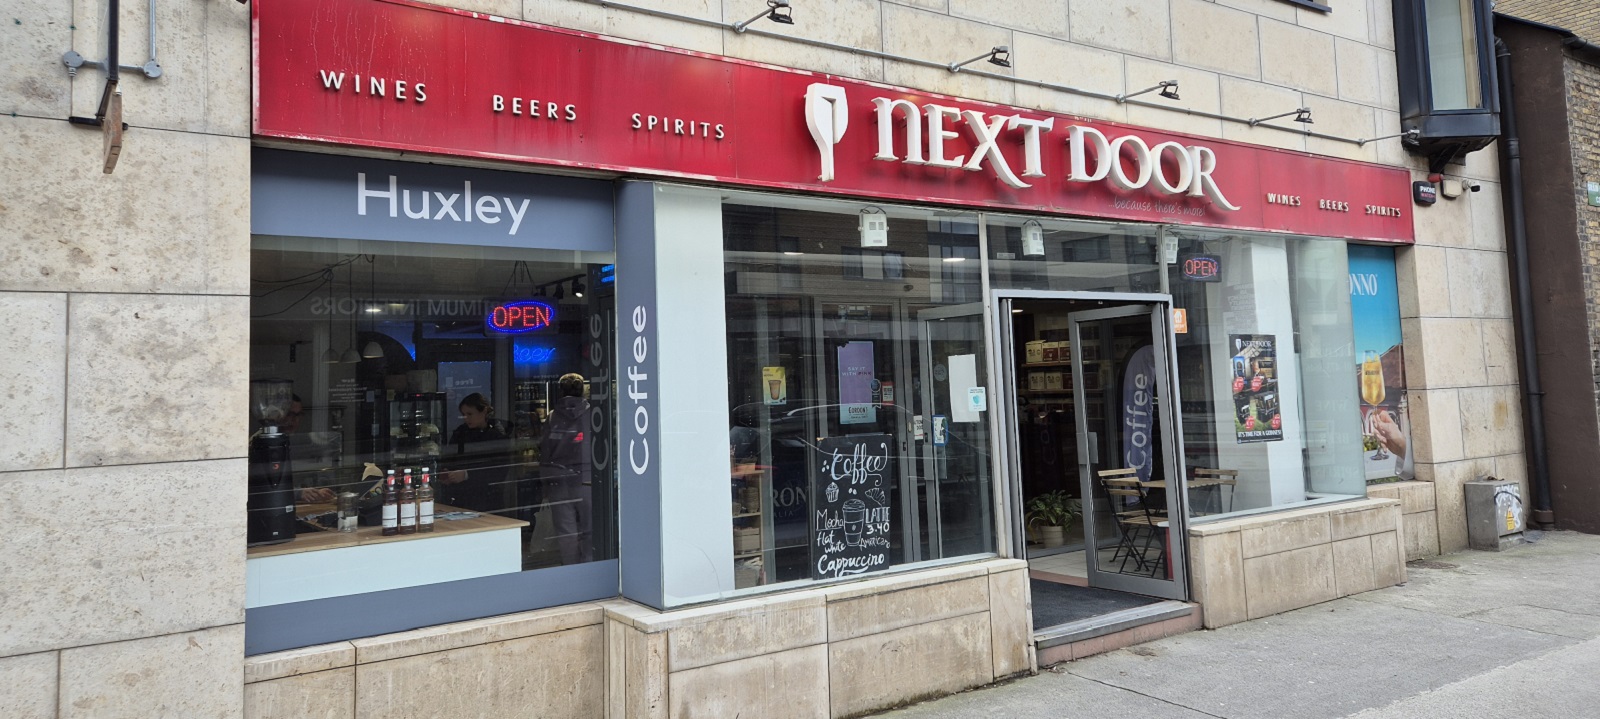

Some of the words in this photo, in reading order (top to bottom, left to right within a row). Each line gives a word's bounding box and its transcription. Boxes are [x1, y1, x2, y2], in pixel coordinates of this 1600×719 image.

[320, 69, 427, 102] WINES
[493, 94, 577, 121] BEERS
[632, 113, 724, 139] SPIRITS
[871, 97, 1054, 188] NEXT
[1066, 125, 1241, 211] DOOR
[1420, 185, 1436, 194] PHONE
[358, 172, 531, 235] Huxley
[1155, 200, 1182, 215] there's
[1267, 192, 1301, 206] WINES
[1319, 198, 1349, 212] BEERS
[1365, 204, 1401, 217] SPIRITS
[1185, 259, 1217, 277] OPEN
[493, 306, 550, 327] OPEN
[627, 305, 650, 475] Coffee
[1126, 373, 1148, 469] Coffee
[829, 442, 888, 485] Coffee
[816, 508, 844, 531] Mocha
[865, 507, 890, 524] LATTE
[866, 522, 890, 535] 3.40
[824, 539, 847, 554] white
[817, 553, 885, 578] Cappuccino
